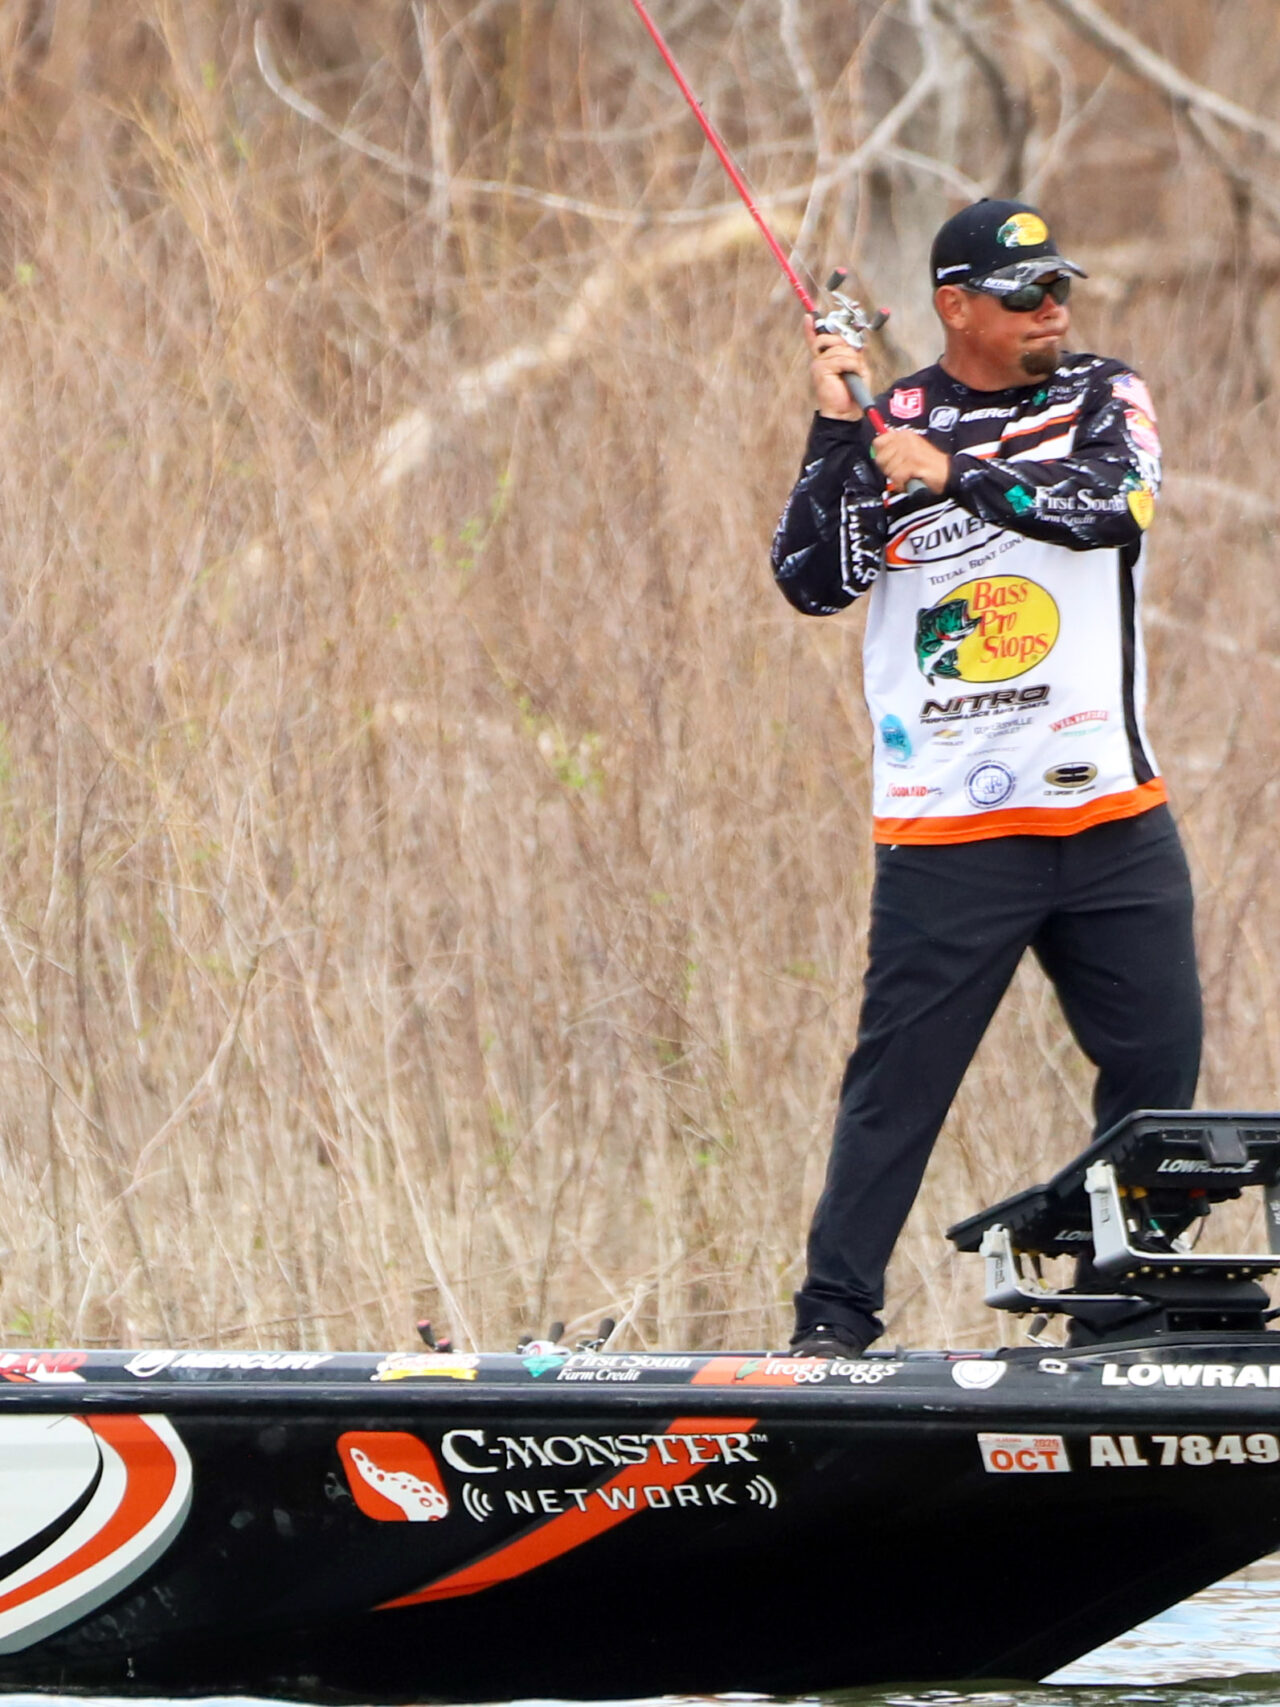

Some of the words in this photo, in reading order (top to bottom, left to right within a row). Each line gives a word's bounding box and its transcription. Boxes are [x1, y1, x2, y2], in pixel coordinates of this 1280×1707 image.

[1030, 485, 1076, 511] First
[999, 534, 1027, 554] CON
[973, 582, 1030, 611] Bass
[979, 610, 1017, 637] Pro
[919, 684, 1050, 718] NITRO
[171, 1354, 335, 1370] MERCURY
[564, 1354, 619, 1368] First
[621, 1354, 693, 1368] South
[764, 1360, 828, 1383] frogg
[556, 1368, 594, 1381] Farm
[595, 1368, 642, 1381] Credit
[990, 1449, 1058, 1471] OCT
[1090, 1435, 1149, 1467] AL
[505, 1483, 737, 1514] NETWORK
